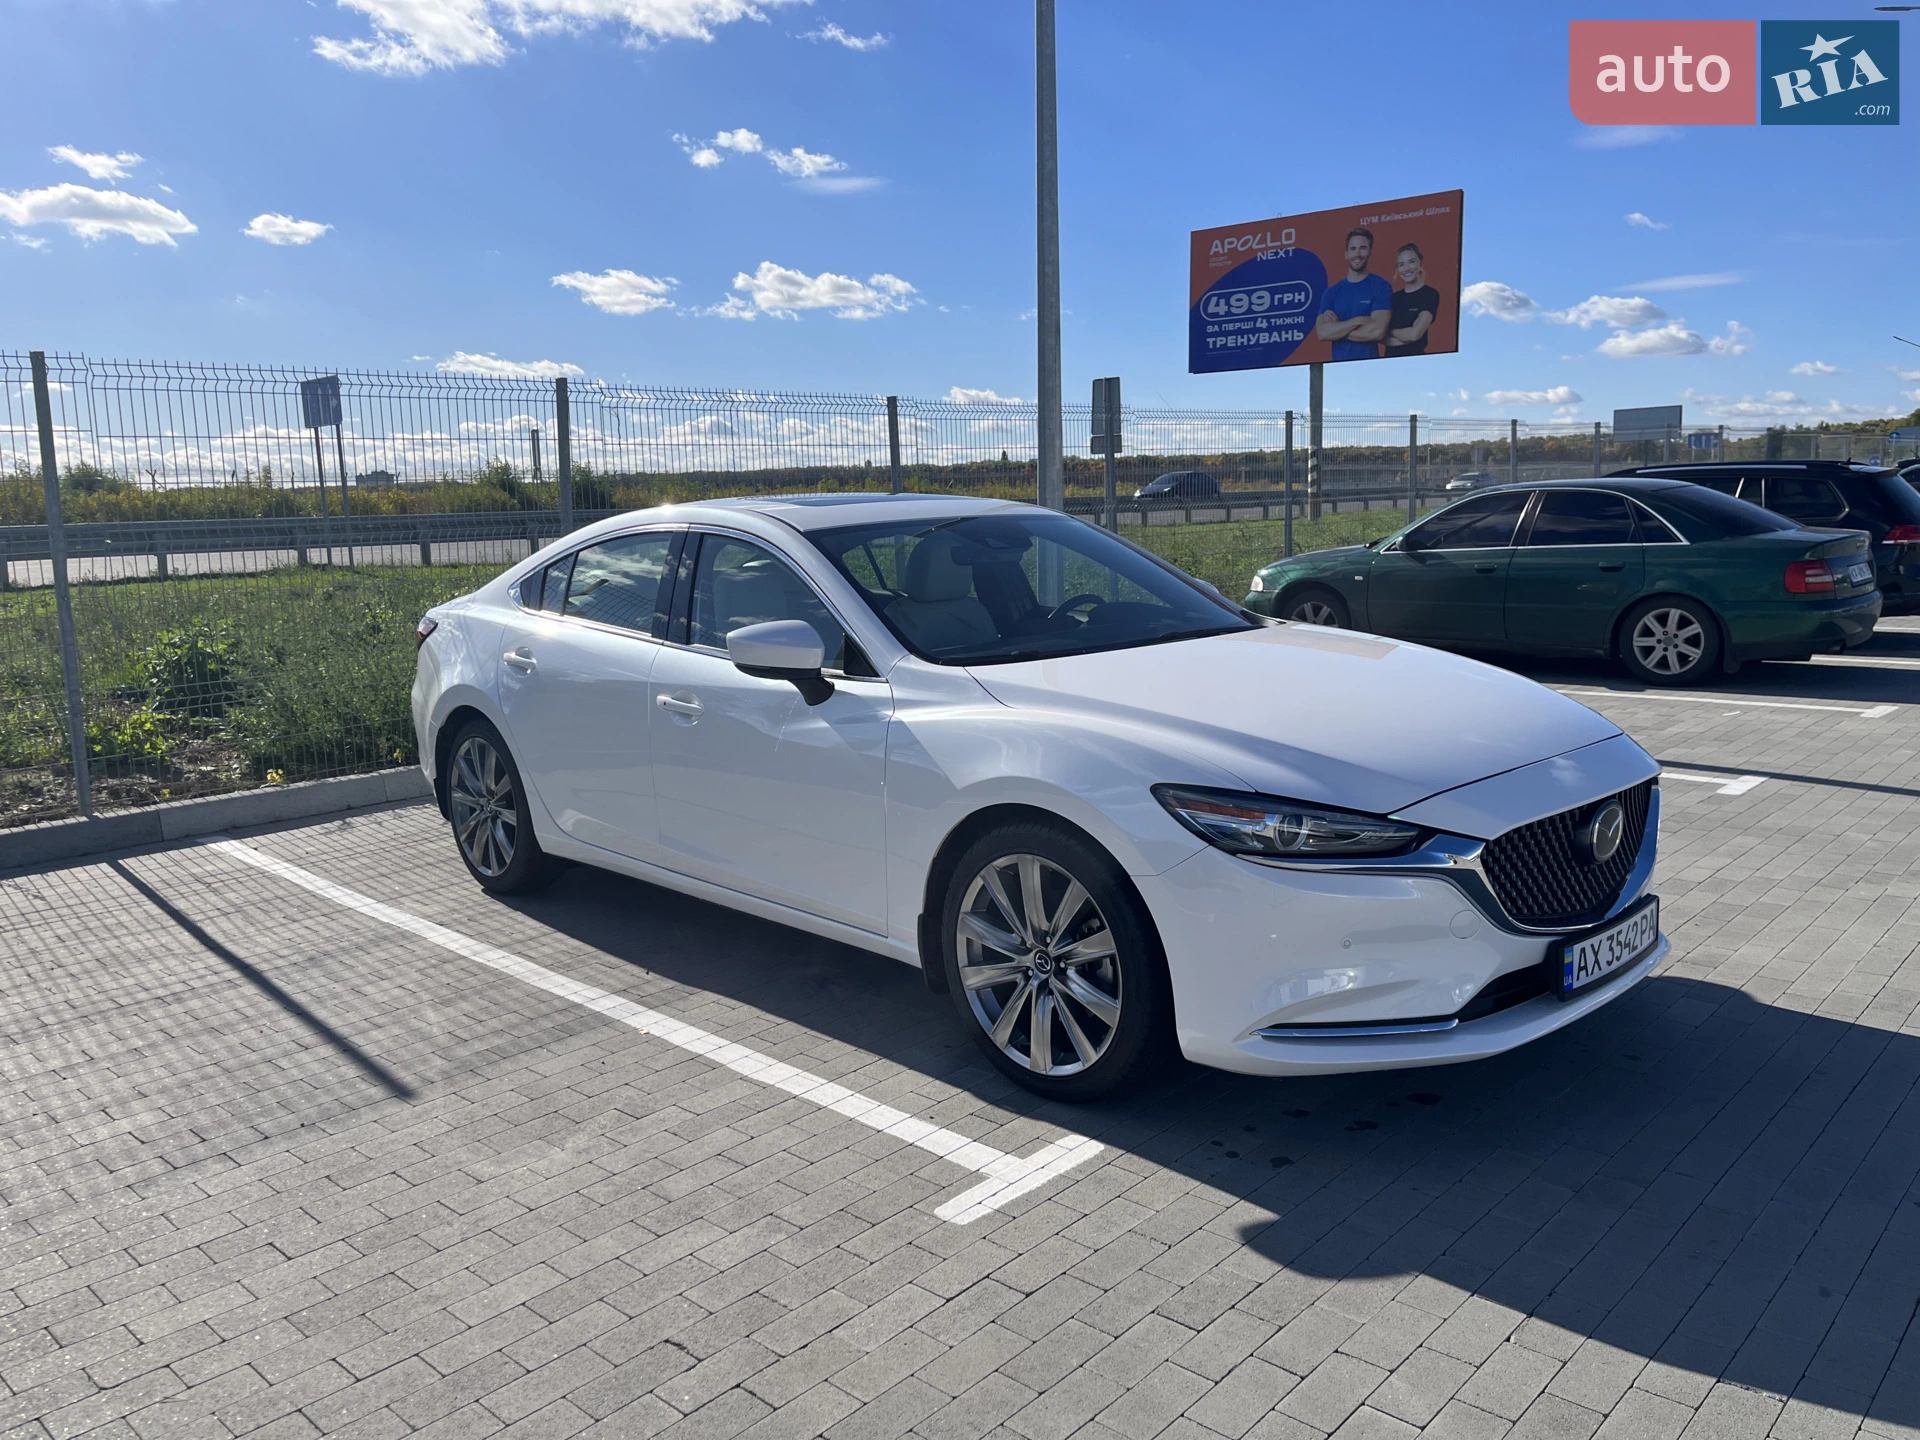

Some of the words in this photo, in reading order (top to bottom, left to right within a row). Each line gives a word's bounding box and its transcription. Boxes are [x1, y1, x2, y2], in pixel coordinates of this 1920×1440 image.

[1360, 215, 1379, 225] ЦУМ
[1380, 209, 1424, 222] Київський
[1425, 206, 1451, 216] Шлях
[1209, 228, 1296, 255] APOLLO
[1257, 246, 1296, 262] NEXT
[1207, 290, 1271, 316] 499
[1274, 291, 1306, 306] ГРН
[1206, 325, 1220, 333] ЗА
[1222, 321, 1254, 331] ПЕРШІ
[1255, 317, 1268, 329] 4
[1270, 315, 1305, 326] ТИЖНІ
[1206, 329, 1305, 349] ТРЕНУВАНЬ
[1576, 939, 1603, 981] AX
[1606, 920, 1639, 967] 3542
